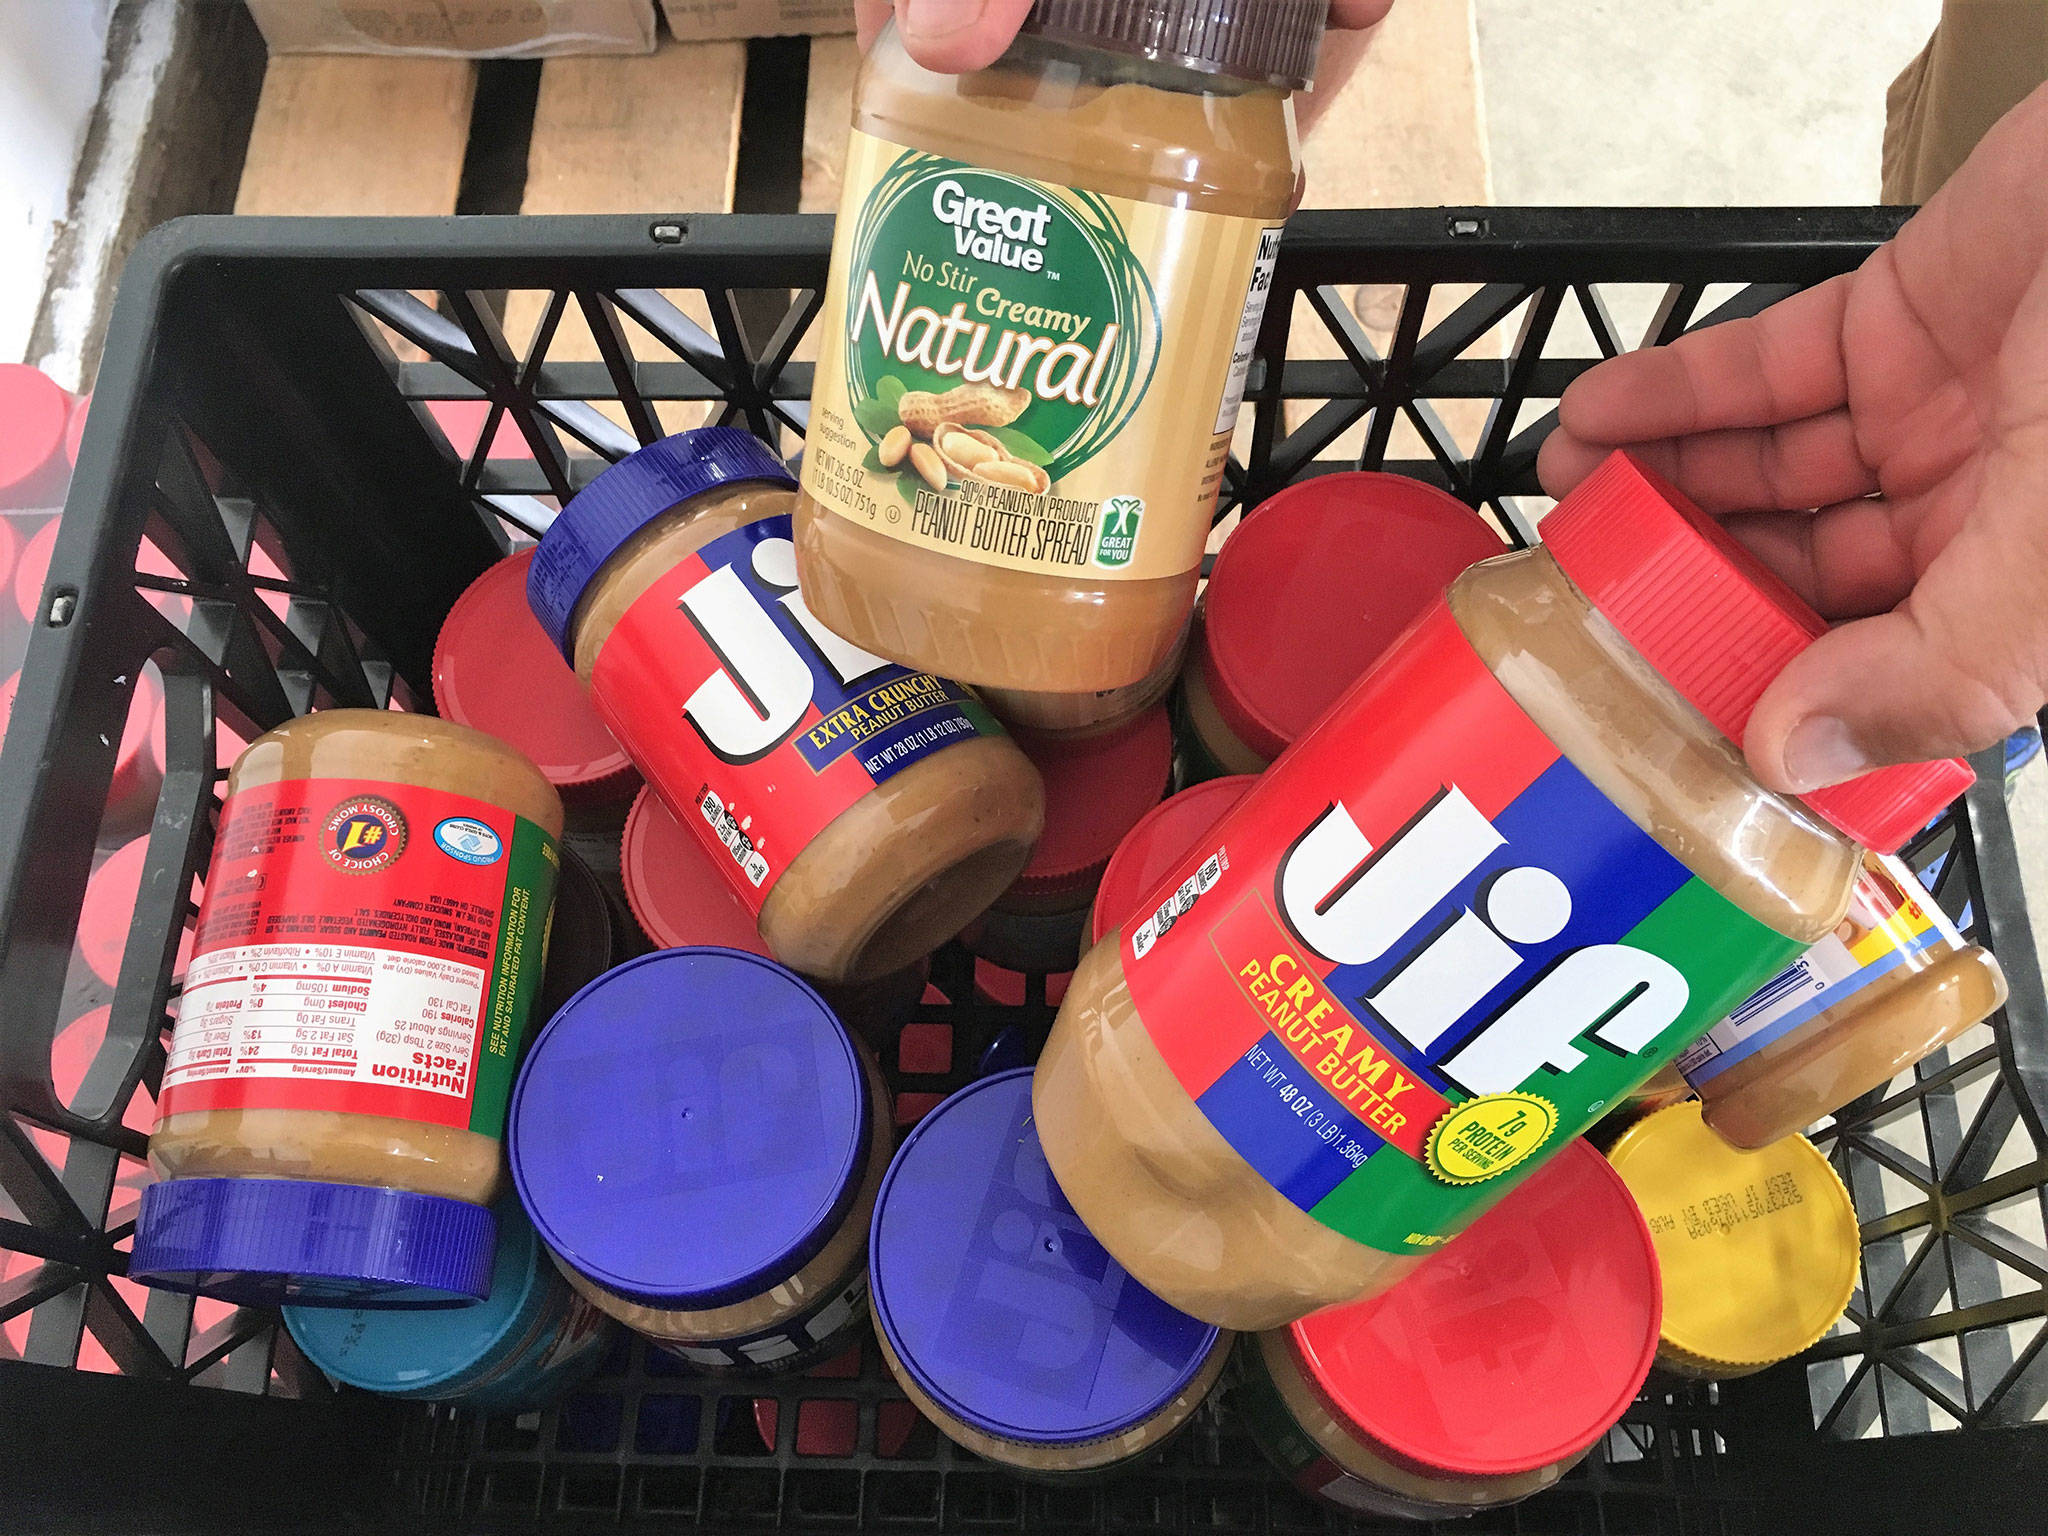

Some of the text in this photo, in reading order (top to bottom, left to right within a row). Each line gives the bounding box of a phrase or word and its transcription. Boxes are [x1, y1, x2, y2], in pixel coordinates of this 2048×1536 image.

[933, 179, 1051, 247] Great
[954, 225, 1044, 273] Value
[902, 250, 977, 294] No Stir
[976, 287, 1091, 342] Creamy
[851, 270, 1120, 407] Natural
[822, 407, 844, 430] serving
[820, 422, 856, 451] suggestion
[816, 448, 864, 488] NET WT 26.5 OZ
[855, 491, 877, 520] 751g
[960, 480, 1099, 524] 90% PEANUTS IN PRODUCT
[912, 491, 1093, 565] PEANUT BUTTER SPREAD
[1100, 548, 1129, 561] FOR YOU
[1101, 537, 1133, 549] GREAT
[808, 674, 944, 750] EXTRA CRUNCHY
[850, 690, 950, 741] PEANUT BUTTER
[864, 754, 882, 775] NET
[880, 748, 896, 766] WT
[896, 741, 908, 758] 28
[906, 734, 920, 752] OZ
[926, 724, 938, 742] LB
[936, 722, 947, 738] 12
[946, 718, 958, 736] OZ)
[703, 796, 716, 815] 190
[328, 803, 399, 837] CHOOSY MOMS
[341, 821, 383, 852] #1
[327, 848, 389, 869] CHOICE OF
[1205, 859, 1218, 880] 190
[1280, 781, 1690, 1097] Jif
[334, 949, 342, 958] E
[343, 950, 376, 961] Vitamin
[262, 962, 268, 972] C
[269, 962, 298, 972] Vitamin
[317, 962, 330, 972] 0%
[333, 963, 340, 972] A
[341, 963, 373, 976] Vitamin
[414, 968, 437, 980] Values
[489, 886, 522, 1054] SEE NUTRITION INFORMATION FOR
[498, 889, 531, 1057] FAT AND SATURATED FAT CONTENT.
[252, 981, 370, 996] Sodium 105mg 4%
[215, 1000, 242, 1010] Protein
[249, 997, 367, 1012] Cholest 0mg 0%
[428, 997, 471, 1015] Fat Cal 130
[296, 1012, 356, 1027] Trans Fat 0g
[422, 1008, 475, 1029] Calories 190
[1269, 953, 1416, 1102] CREAMY
[244, 1028, 354, 1043] Sat Fat 2.5g 13%
[376, 1030, 469, 1058] Serv Size 2 Tbsp (32g)
[394, 1020, 472, 1044] Servings About 25
[212, 1047, 232, 1058] Total
[240, 1044, 358, 1060] Total Fat 16g 24%
[1239, 958, 1408, 1136] PEANUT BUTTER
[292, 1065, 355, 1077] Amount/Serving
[412, 1052, 467, 1077] Facts
[372, 1064, 464, 1094] Nutrition
[1244, 1044, 1369, 1169] NET WT 48 OZ (3 LB) 1.36kg
[1497, 1110, 1528, 1138] 7g
[1457, 1120, 1516, 1161] PROTEIN
[1448, 1138, 1494, 1170] PER SERVING
